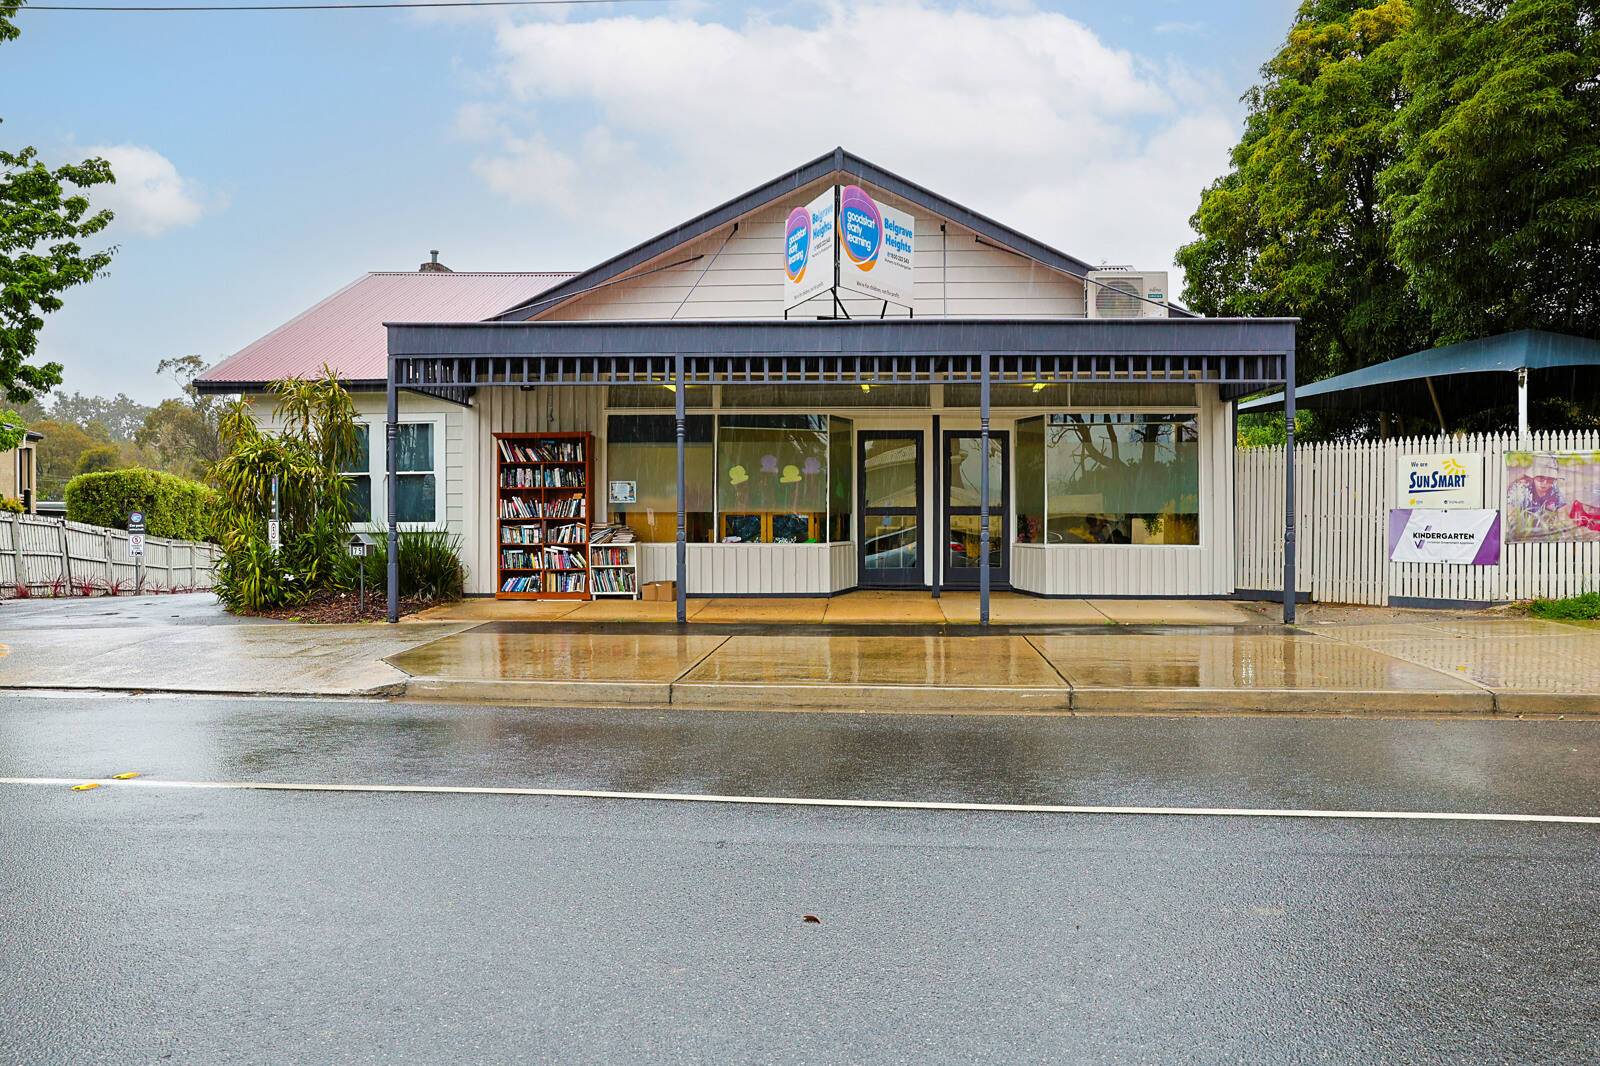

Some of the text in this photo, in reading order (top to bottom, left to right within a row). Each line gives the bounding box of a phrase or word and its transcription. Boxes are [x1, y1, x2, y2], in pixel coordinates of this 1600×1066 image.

[847, 211, 875, 229] goodstart
[847, 222, 862, 237] early
[884, 217, 912, 238] Belgrave
[813, 222, 832, 240] Heights
[847, 231, 871, 251] learning
[885, 233, 911, 253] Heights
